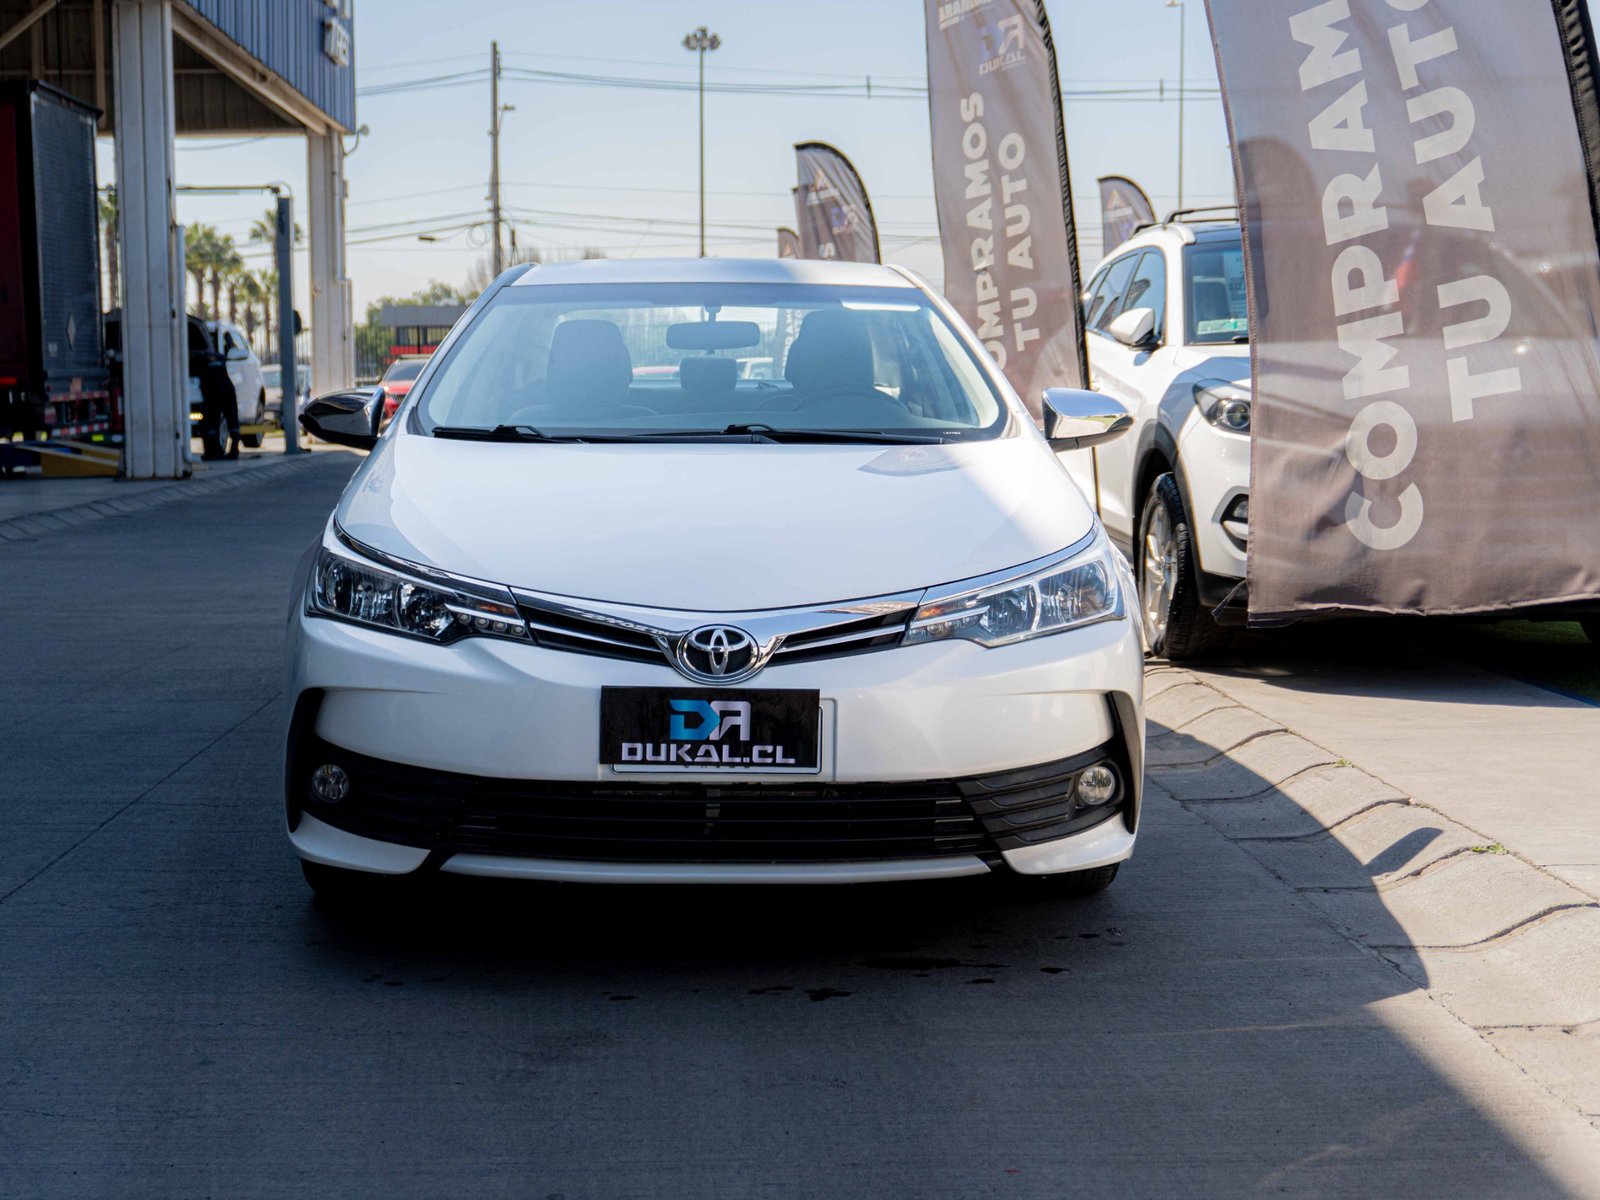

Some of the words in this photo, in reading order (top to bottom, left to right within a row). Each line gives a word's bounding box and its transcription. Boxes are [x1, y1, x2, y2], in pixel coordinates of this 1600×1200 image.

[979, 50, 1026, 75] DUKAL
[1383, 0, 1496, 232] AUT
[960, 92, 1007, 371] OMPRAMOS
[999, 132, 1034, 270] AUTO
[1010, 287, 1040, 352] TU
[1437, 274, 1522, 423] TU
[621, 742, 796, 764] DUKAL.CL
